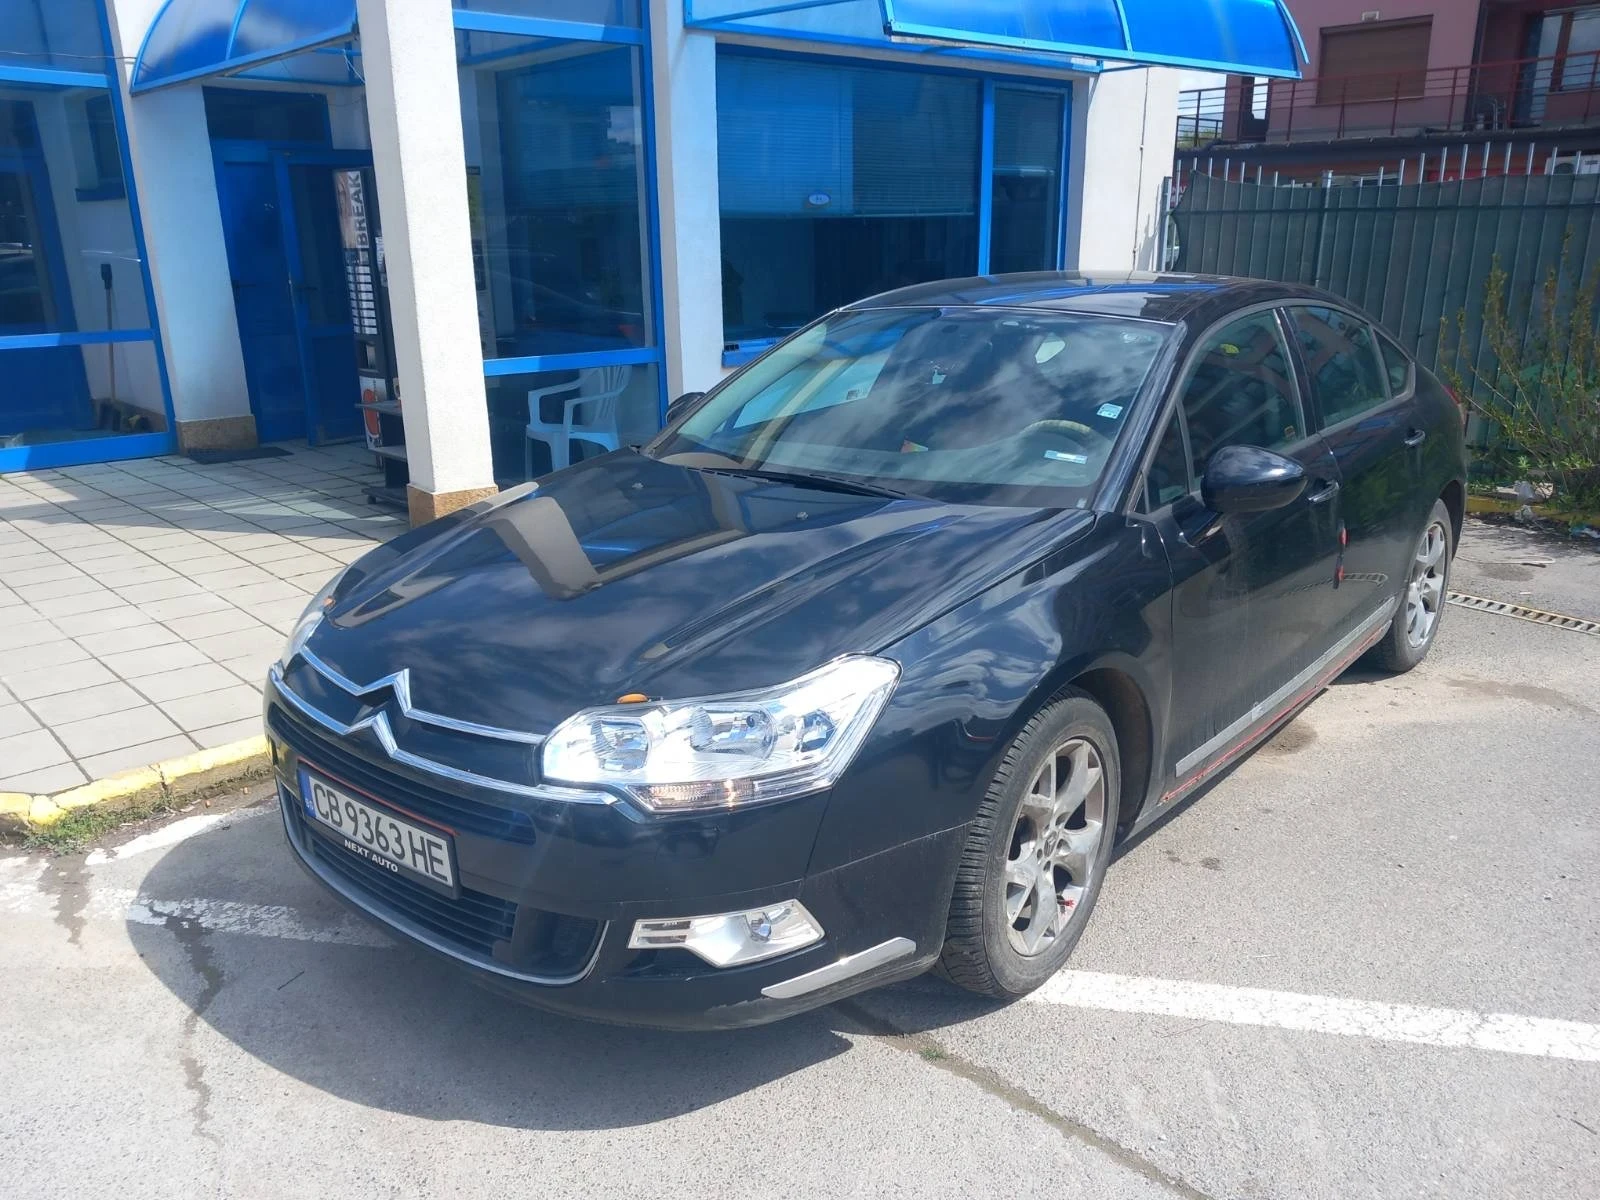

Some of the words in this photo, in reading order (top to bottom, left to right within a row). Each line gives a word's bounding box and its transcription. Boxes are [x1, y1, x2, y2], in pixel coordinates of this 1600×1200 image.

[348, 174, 369, 246] BREAK
[344, 839, 369, 857] NEXT
[371, 854, 399, 873] AUTO
